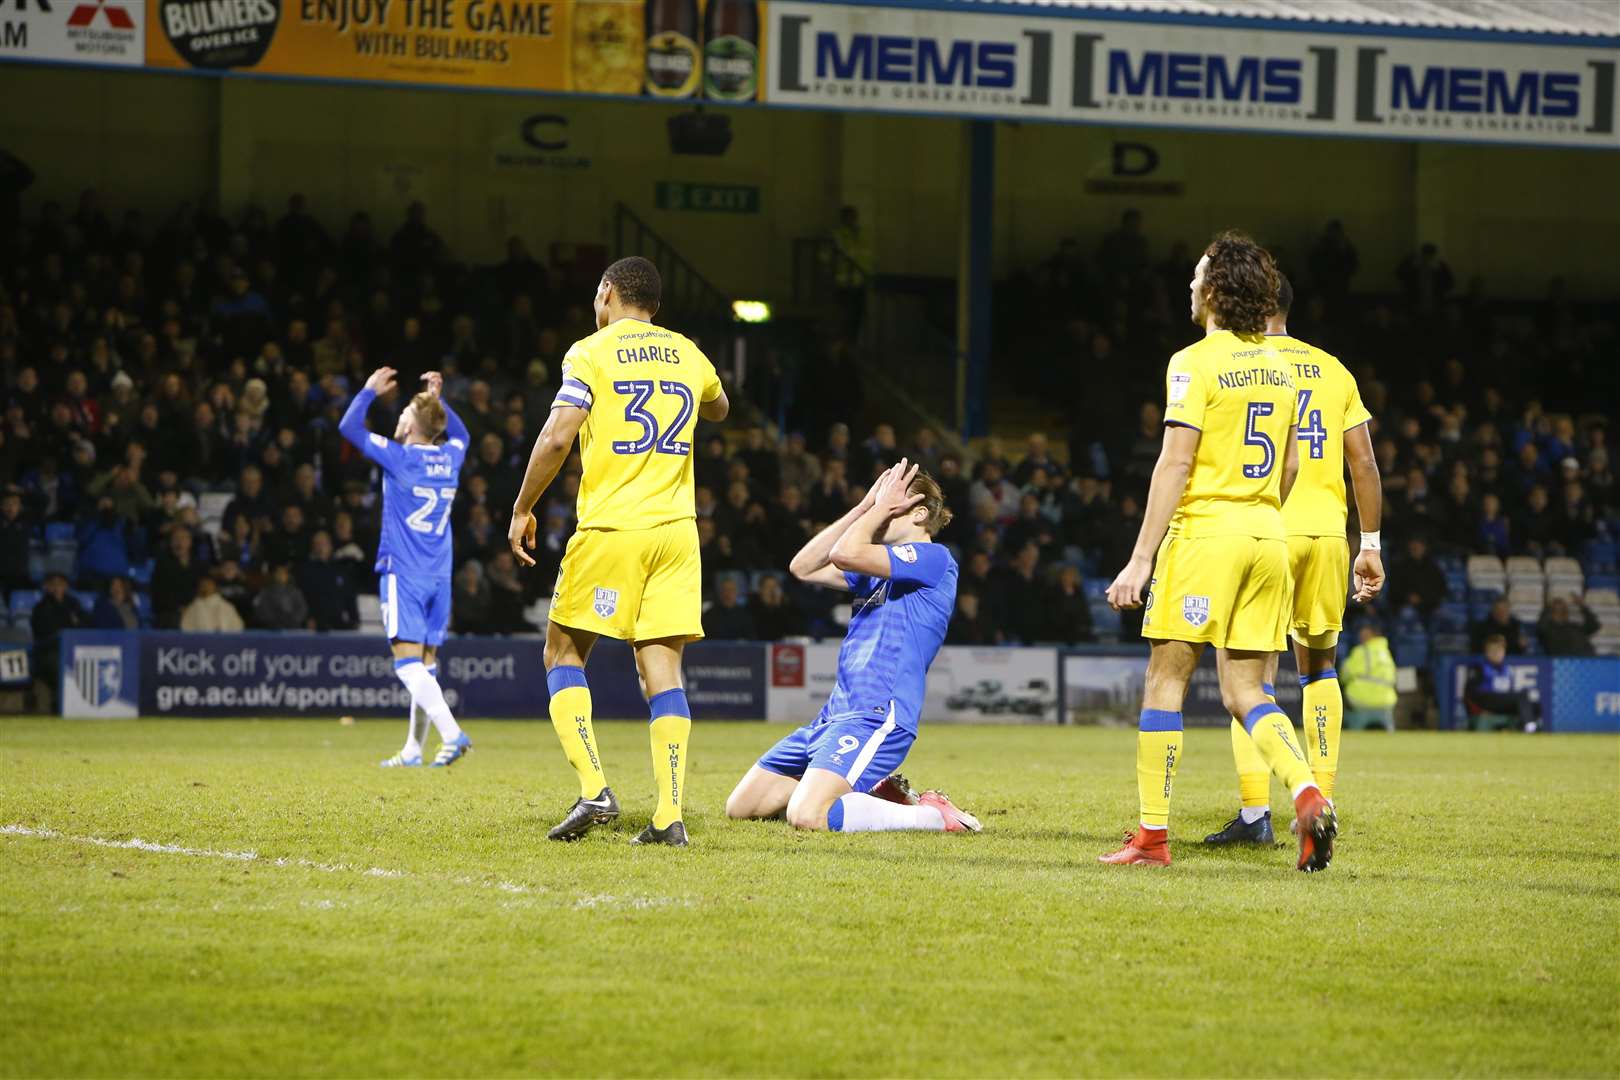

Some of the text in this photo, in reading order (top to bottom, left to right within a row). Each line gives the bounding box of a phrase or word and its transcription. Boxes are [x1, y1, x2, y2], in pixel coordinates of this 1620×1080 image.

[165, 0, 277, 37] BULMERS
[300, 0, 553, 36] ENJOY THE GAME
[75, 42, 126, 55] MOTORS
[190, 27, 258, 52] OVER ICE
[355, 32, 510, 62] WITH BULMERS
[817, 31, 1016, 88] MEMS
[1108, 50, 1302, 104] MEMS
[814, 84, 1016, 105] POWER GENERATION
[1391, 65, 1580, 117] MEMS
[1106, 100, 1302, 119] POWER GENERATION
[1389, 114, 1580, 133] POWER GENERATION
[521, 114, 570, 150] C
[1112, 142, 1159, 177] D
[617, 345, 680, 365] CHARLES
[1218, 368, 1295, 390] NIGHTINGAL
[612, 380, 694, 456] 32
[1243, 401, 1275, 478] 5
[405, 486, 457, 536] 27
[157, 648, 216, 676] Kick
[222, 648, 258, 677] off
[263, 653, 323, 682] your
[447, 653, 515, 684] sport
[575, 715, 600, 772] WIMBLEDON
[836, 735, 860, 755] 9
[1315, 705, 1328, 758] WIMBLEDON
[668, 743, 680, 806] WIMBLEDON
[1163, 744, 1177, 799] WIMBLEDON
